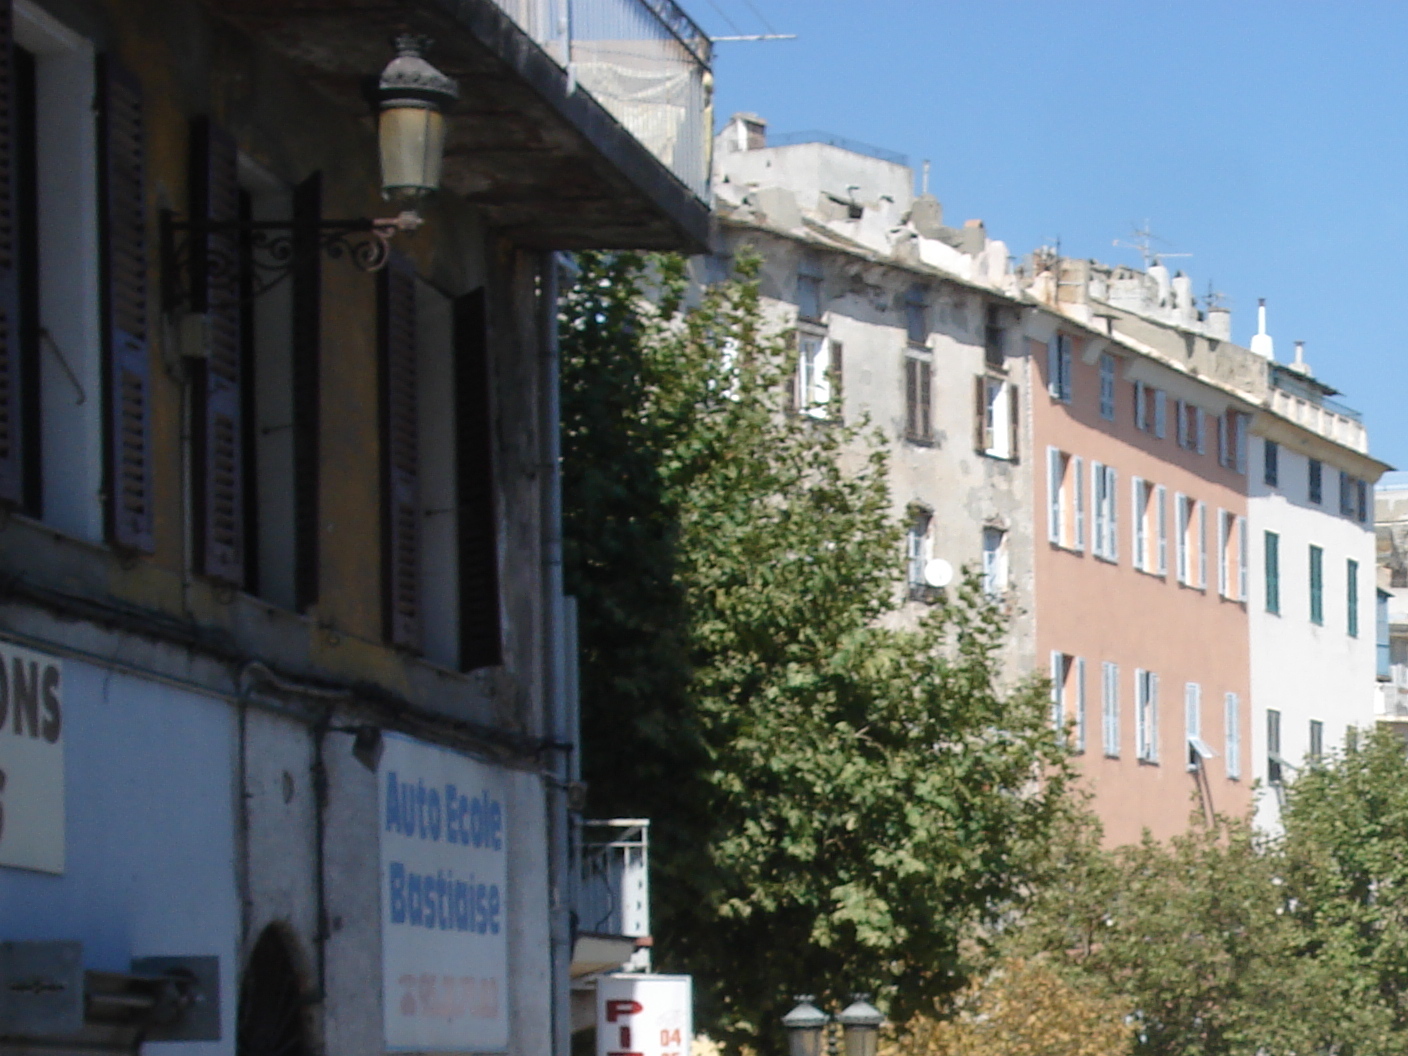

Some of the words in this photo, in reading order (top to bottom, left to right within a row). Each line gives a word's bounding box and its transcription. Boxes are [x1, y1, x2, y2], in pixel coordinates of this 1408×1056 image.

[386, 770, 441, 841] Auto
[445, 783, 502, 851] Ecole
[390, 861, 501, 935] Bastiaise
[660, 1028, 682, 1047] 04
